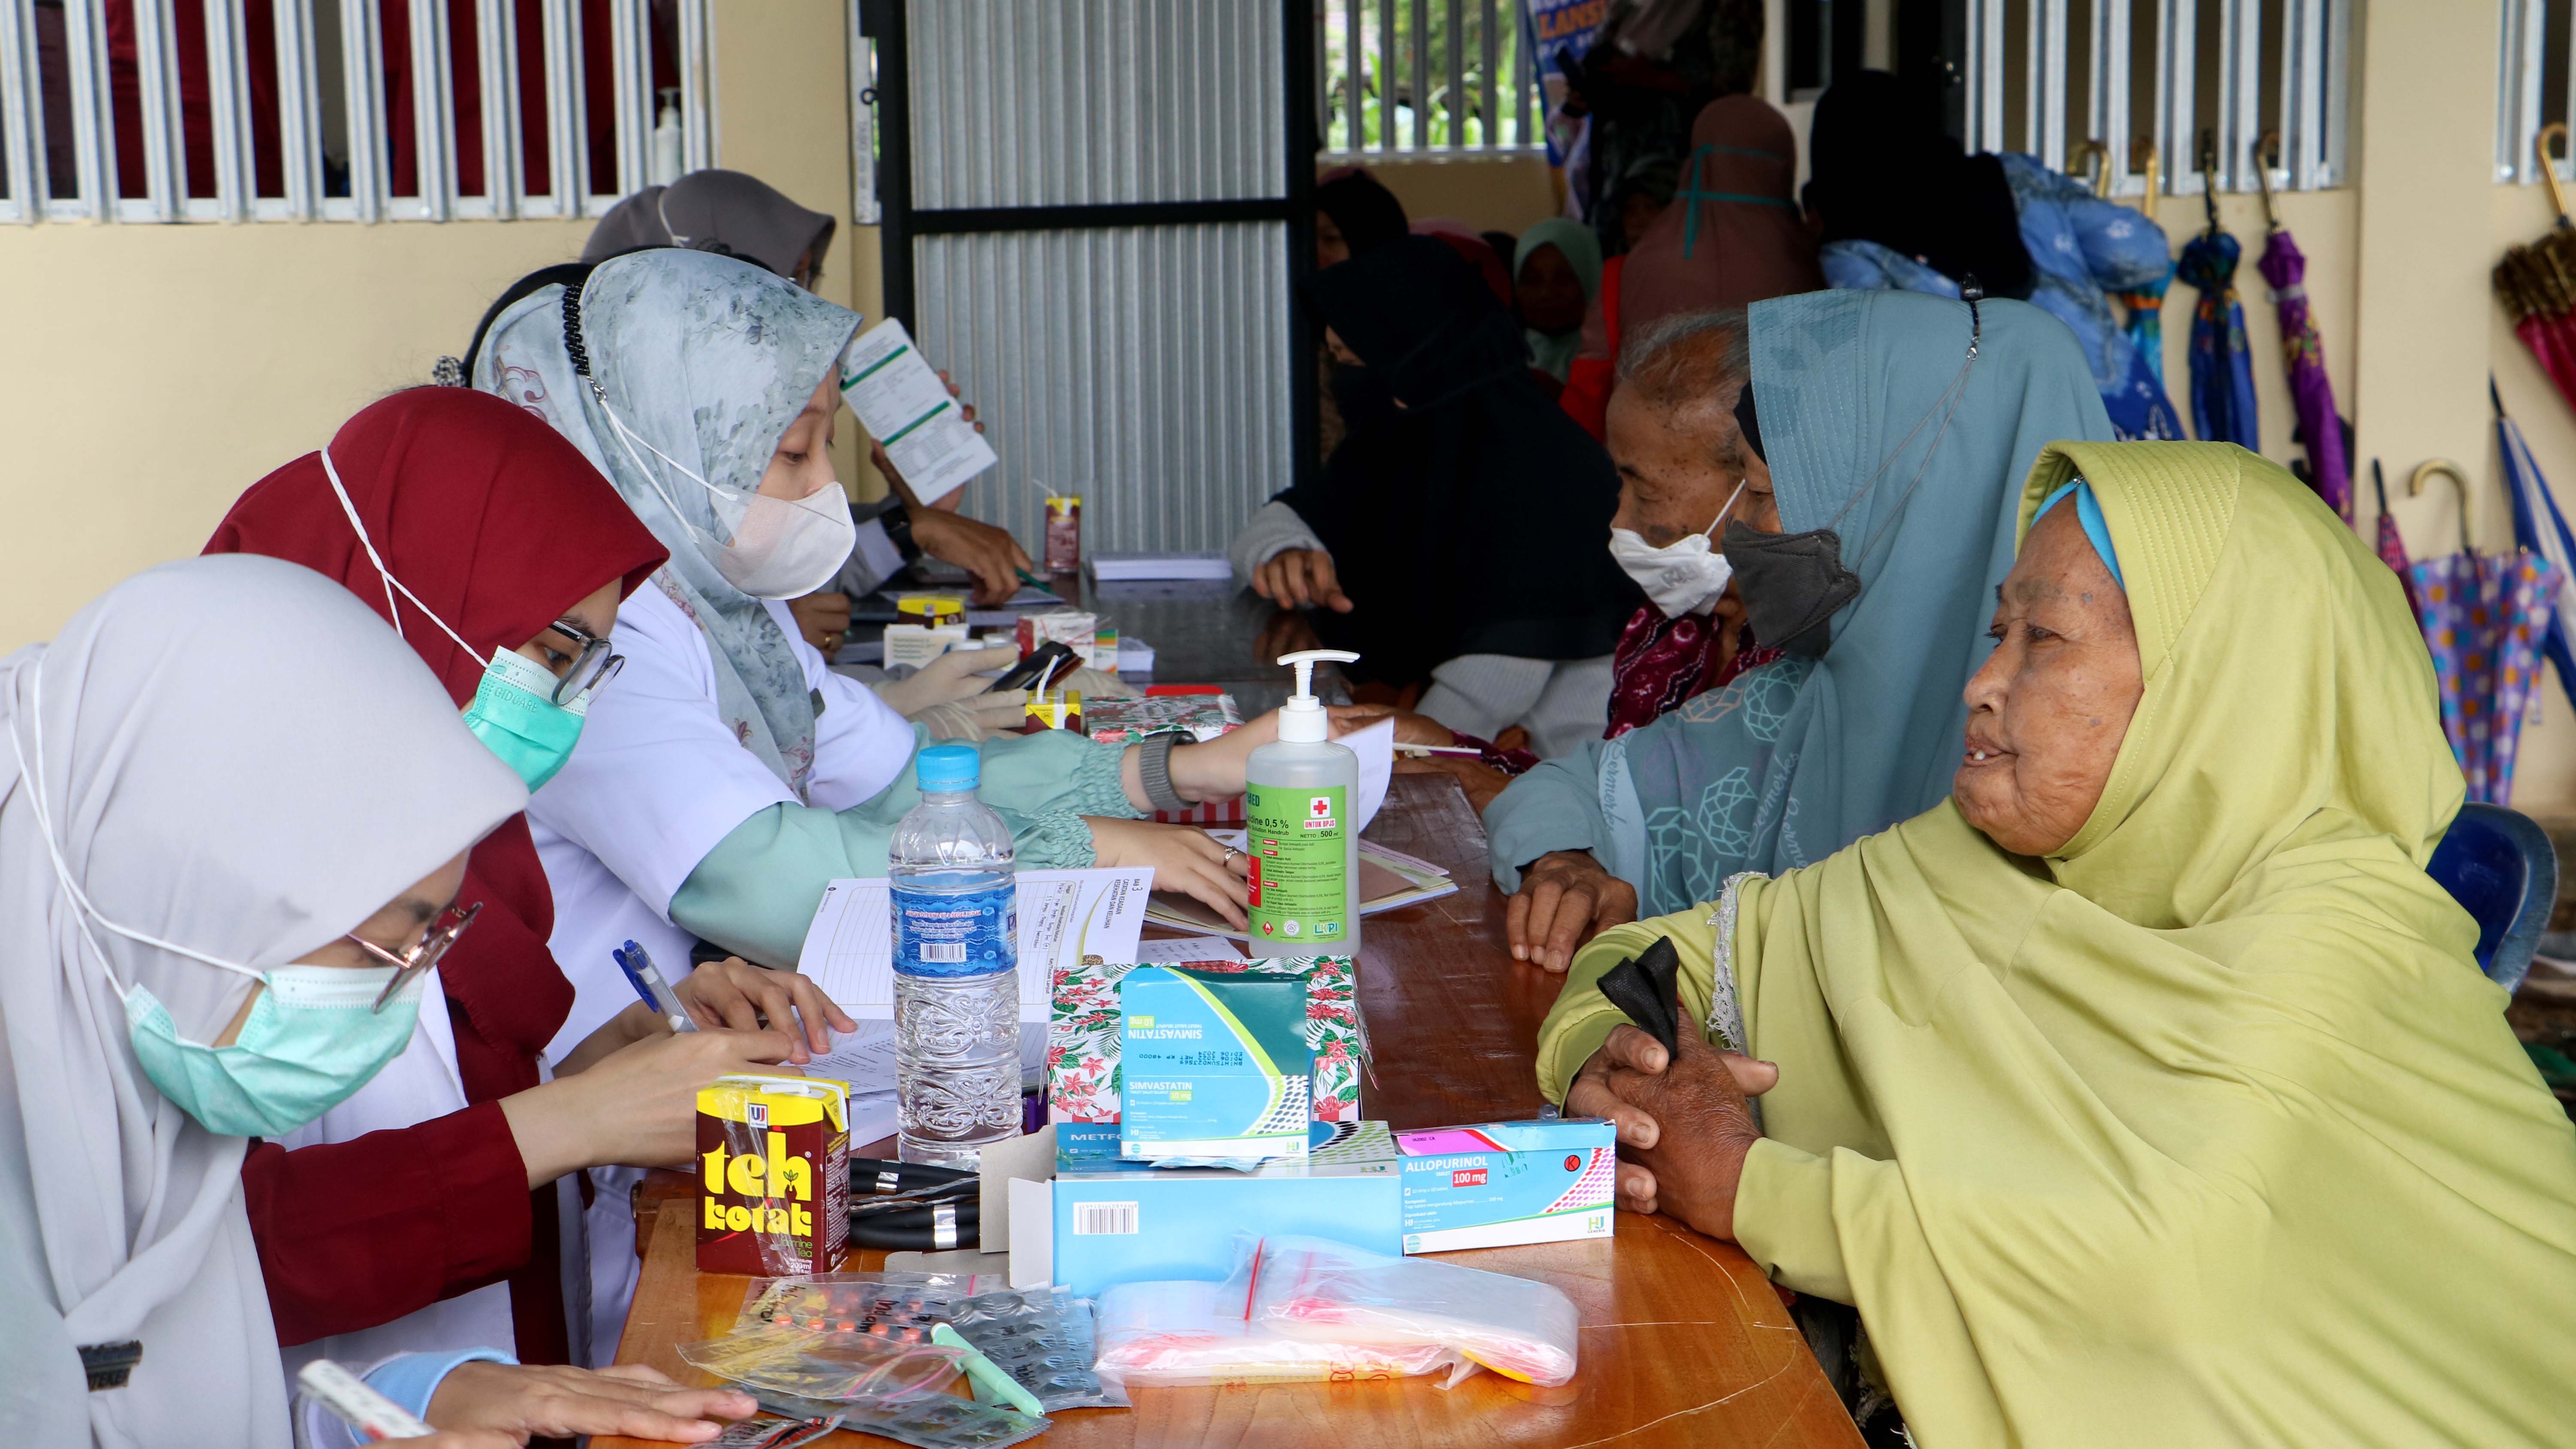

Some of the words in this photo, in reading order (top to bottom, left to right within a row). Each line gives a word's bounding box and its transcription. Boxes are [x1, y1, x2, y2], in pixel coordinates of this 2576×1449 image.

[1120, 878, 1129, 896] CATATAN
[1133, 878, 1141, 887] BAB
[1110, 879, 1121, 901] KESEHATAN
[1115, 896, 1125, 914] KEADAAN
[1103, 910, 1114, 929] KELUHAN
[1130, 1017, 1142, 1025] mg
[1144, 1018, 1154, 1026] 10
[1128, 1030, 1203, 1039] SIMVASTATIN
[1129, 1082, 1192, 1090] SIMVASTATIN
[702, 1132, 812, 1202] teh
[1405, 1156, 1488, 1173] ALLOPURINOL
[1454, 1173, 1471, 1184] 100
[1472, 1173, 1487, 1184] mg
[705, 1196, 812, 1237] kotak
[797, 1247, 813, 1258] Tea
